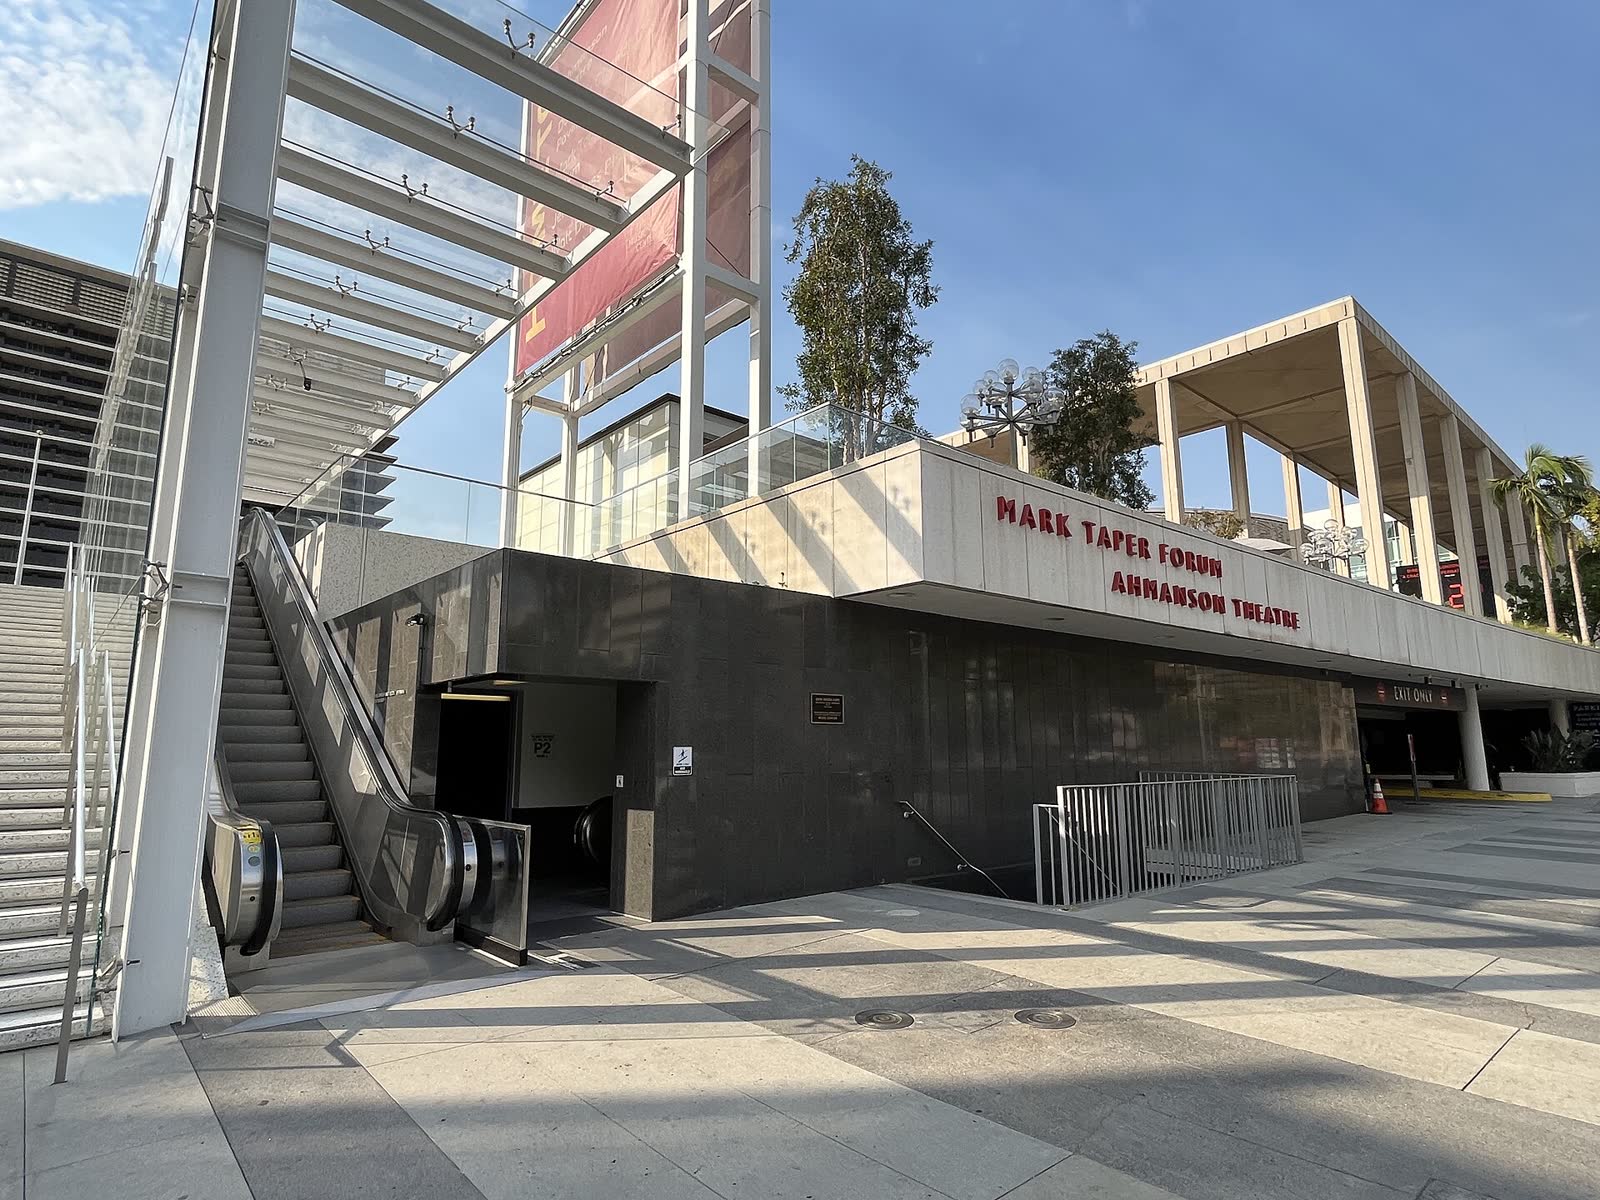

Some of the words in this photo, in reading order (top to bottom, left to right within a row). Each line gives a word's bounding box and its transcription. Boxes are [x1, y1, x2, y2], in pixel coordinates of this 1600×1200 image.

[996, 495, 1072, 538] MARK
[1081, 520, 1151, 560] TAPER
[1159, 543, 1223, 579] FORUM
[1111, 571, 1226, 615] AHMANSON
[1231, 598, 1301, 631] THEATRE
[1393, 686, 1411, 701] EXIT
[1413, 688, 1433, 703] ONLY
[534, 742, 551, 754] P2
